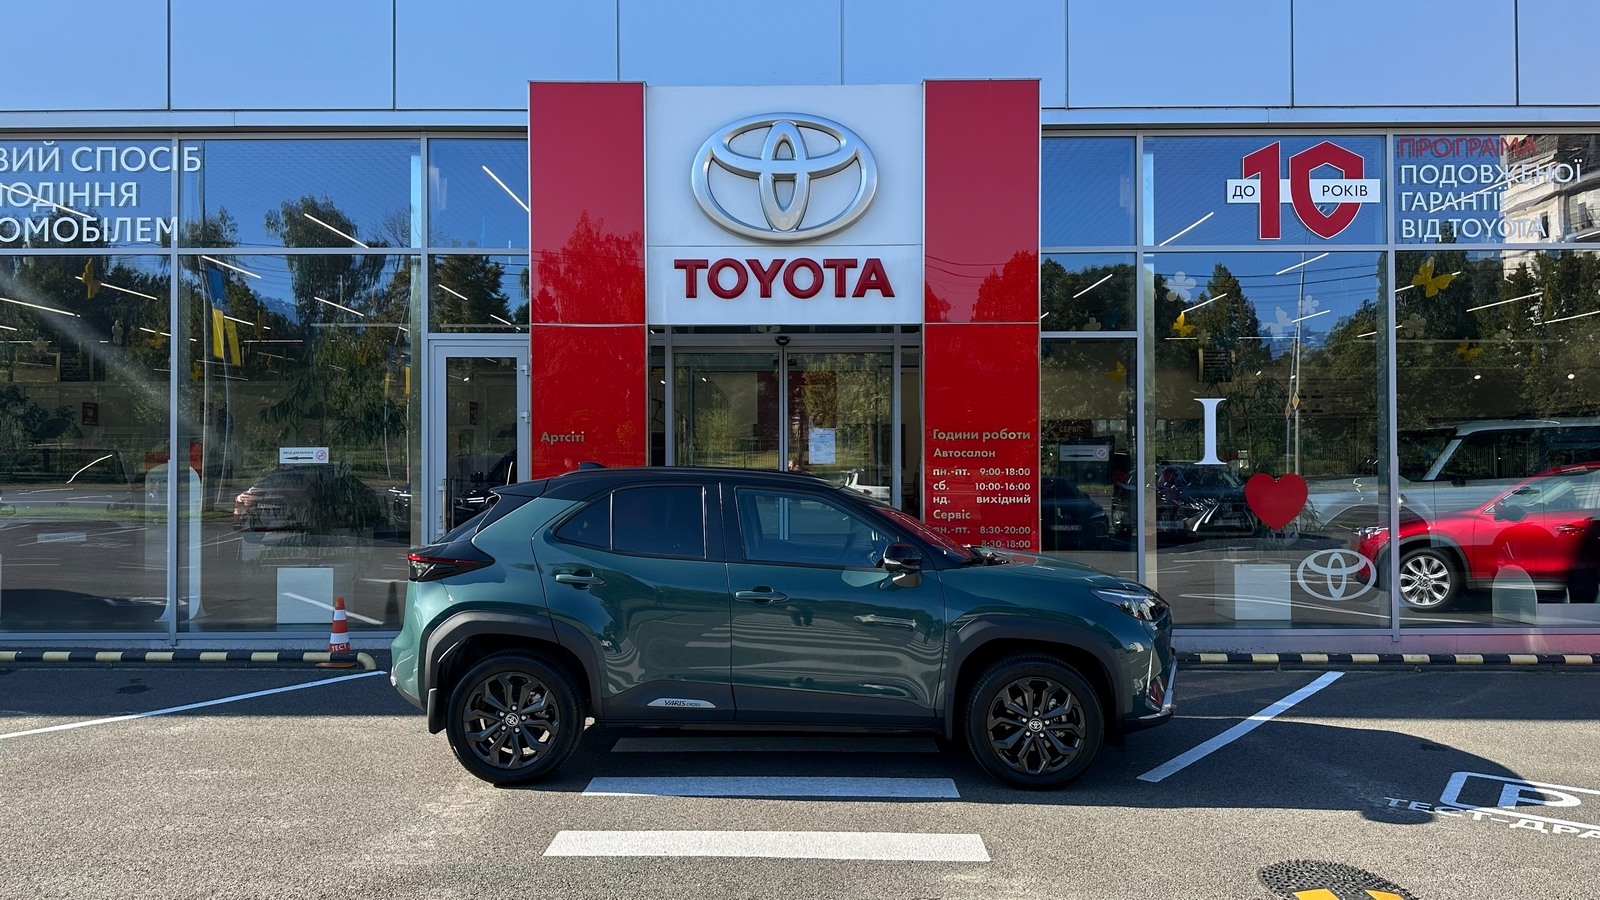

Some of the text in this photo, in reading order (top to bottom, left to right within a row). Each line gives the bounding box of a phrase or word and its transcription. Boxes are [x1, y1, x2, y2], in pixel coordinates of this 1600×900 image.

[1400, 137, 1538, 157] ПРОГРАМА
[71, 146, 201, 172] СПОСІБ
[1401, 159, 1583, 188] ПОДОВЖЕНОЇ
[0, 181, 137, 212] ОДІННЯ
[1232, 140, 1368, 240] ДО 10 РОКІВ
[1401, 186, 1508, 211] ГАРАНТІЇ
[0, 216, 178, 242] ОМОБІЛЕМ
[1402, 218, 1547, 242] ВІД TOYOTA
[674, 257, 895, 299] TOYOTA
[540, 430, 585, 445] Артсіті
[933, 428, 1031, 443] Години роботи
[933, 448, 996, 457] Автосалон
[933, 467, 1030, 476] пн.-пт. 9:00-18:00
[933, 480, 1030, 491] сб. 10:00-16:00
[933, 493, 1031, 505] нд. вихідний
[933, 509, 971, 521] Сервіс
[980, 526, 1030, 534] 8:30-20:00
[981, 540, 1030, 548] 8:30-18:00
